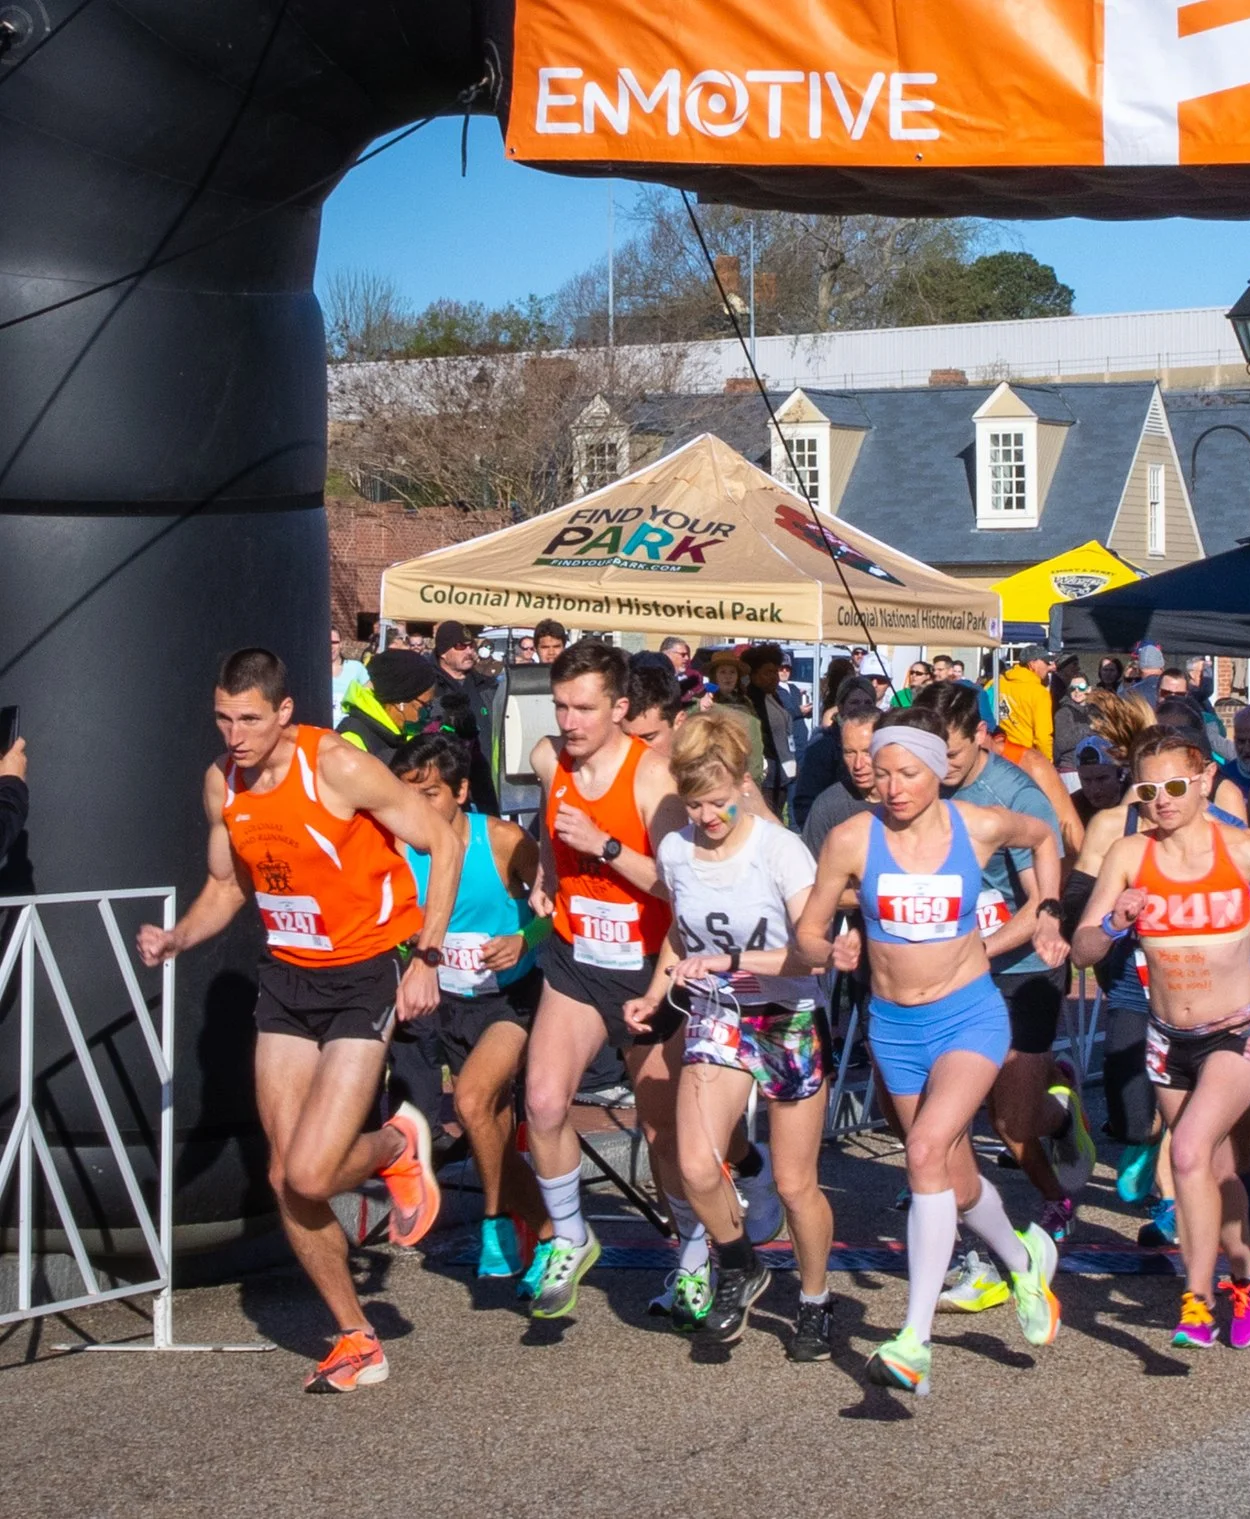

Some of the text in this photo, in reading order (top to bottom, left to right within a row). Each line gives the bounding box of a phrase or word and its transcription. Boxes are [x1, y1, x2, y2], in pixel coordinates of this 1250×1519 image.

[567, 504, 736, 538] FIND YOUR
[541, 521, 726, 564] PARK
[551, 558, 682, 573] FINDYOURPARK.COM
[419, 584, 783, 623] Colonial National Historical Park
[837, 605, 878, 626] Colonial
[879, 609, 920, 629] National
[922, 609, 966, 631] Historical
[966, 611, 987, 631] Park
[270, 911, 317, 935] 1247
[889, 896, 949, 924] 1159
[580, 916, 631, 943] 1190
